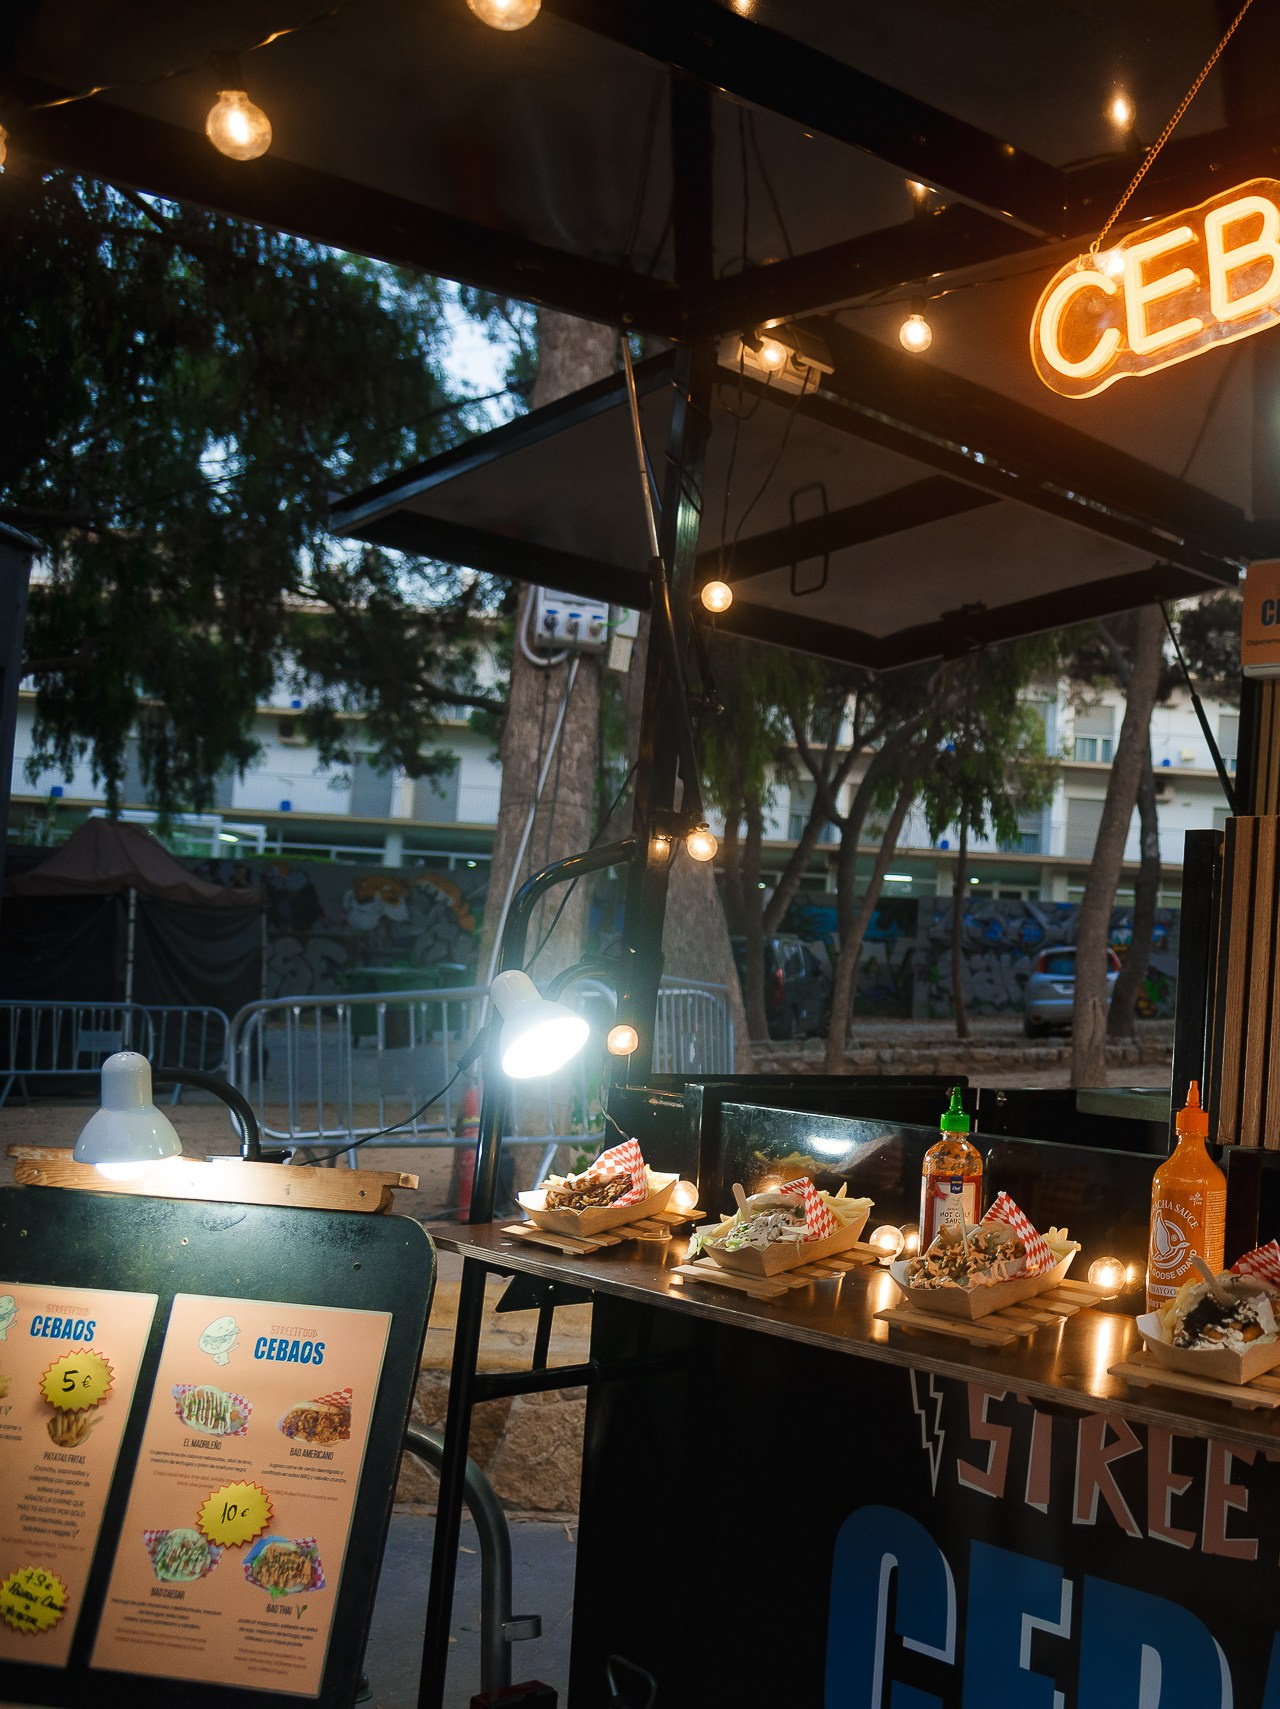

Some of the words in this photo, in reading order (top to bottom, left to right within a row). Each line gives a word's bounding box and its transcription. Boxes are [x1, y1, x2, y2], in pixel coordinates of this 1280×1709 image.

[1174, 1203, 1199, 1230] SAUCE
[1176, 1249, 1198, 1277] BRAND
[30, 1315, 97, 1342] CEBAOS
[270, 1324, 318, 1339] STREETFOOD
[253, 1336, 326, 1366] CEBAOS
[183, 1437, 190, 1448] EL
[190, 1438, 223, 1451] MADRILEÑO
[43, 1451, 67, 1463] PATATAS
[67, 1454, 87, 1465] FRITAS
[289, 1447, 302, 1457] BAO
[302, 1448, 334, 1461] AMERICANO
[150, 1586, 163, 1598] BAO
[266, 1603, 279, 1615] BAO
[279, 1604, 293, 1616] THAI
